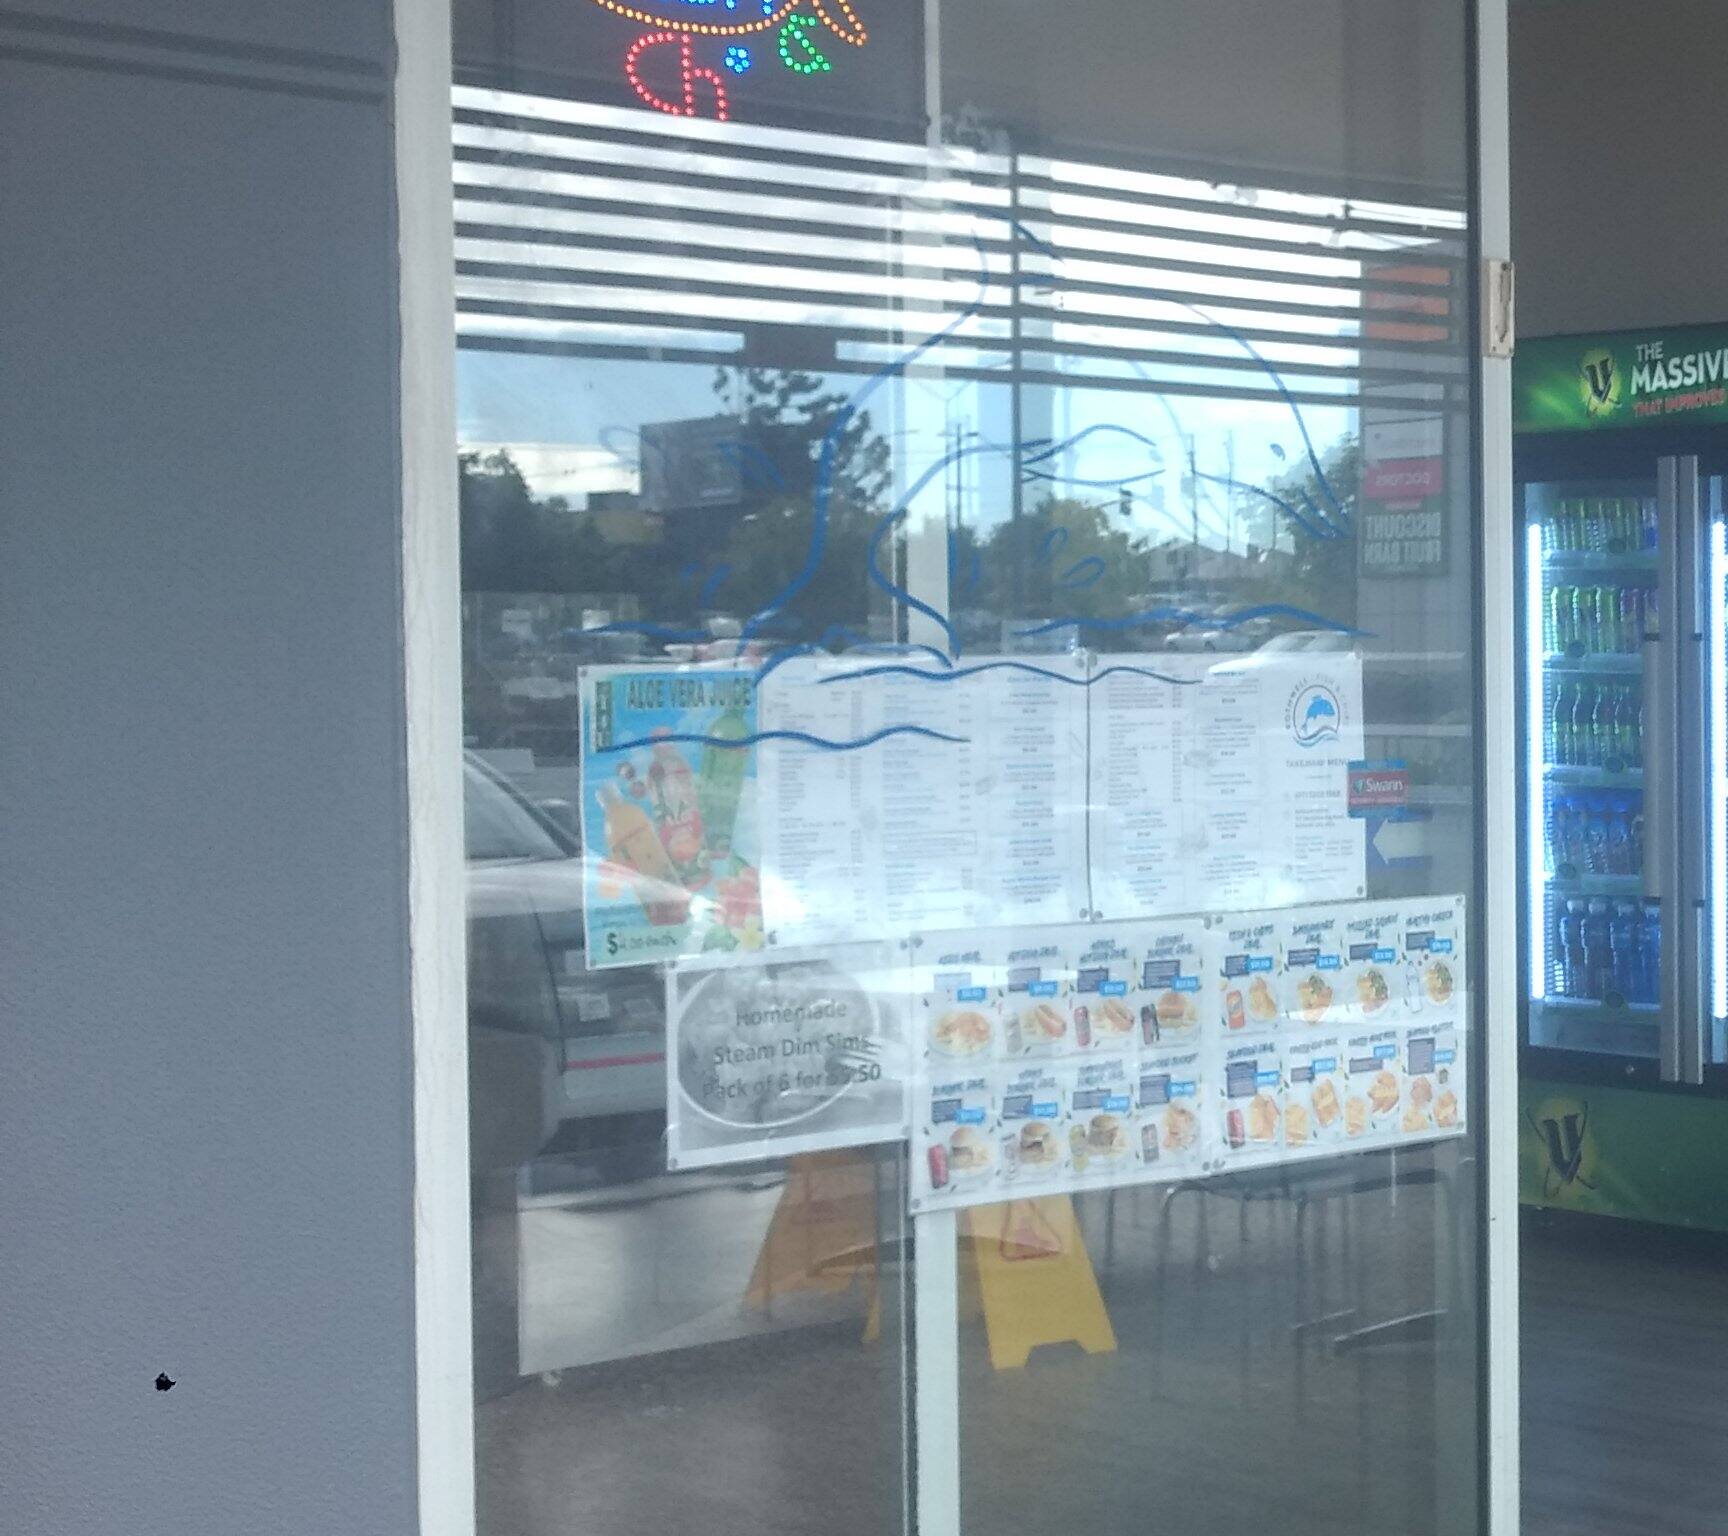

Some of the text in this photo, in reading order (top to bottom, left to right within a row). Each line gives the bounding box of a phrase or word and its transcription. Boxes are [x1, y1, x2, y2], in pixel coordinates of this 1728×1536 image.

[1634, 340, 1664, 363] THE
[1366, 777, 1404, 792] Swann
[713, 1045, 775, 1065] Steam
[782, 1038, 820, 1057] Dim
